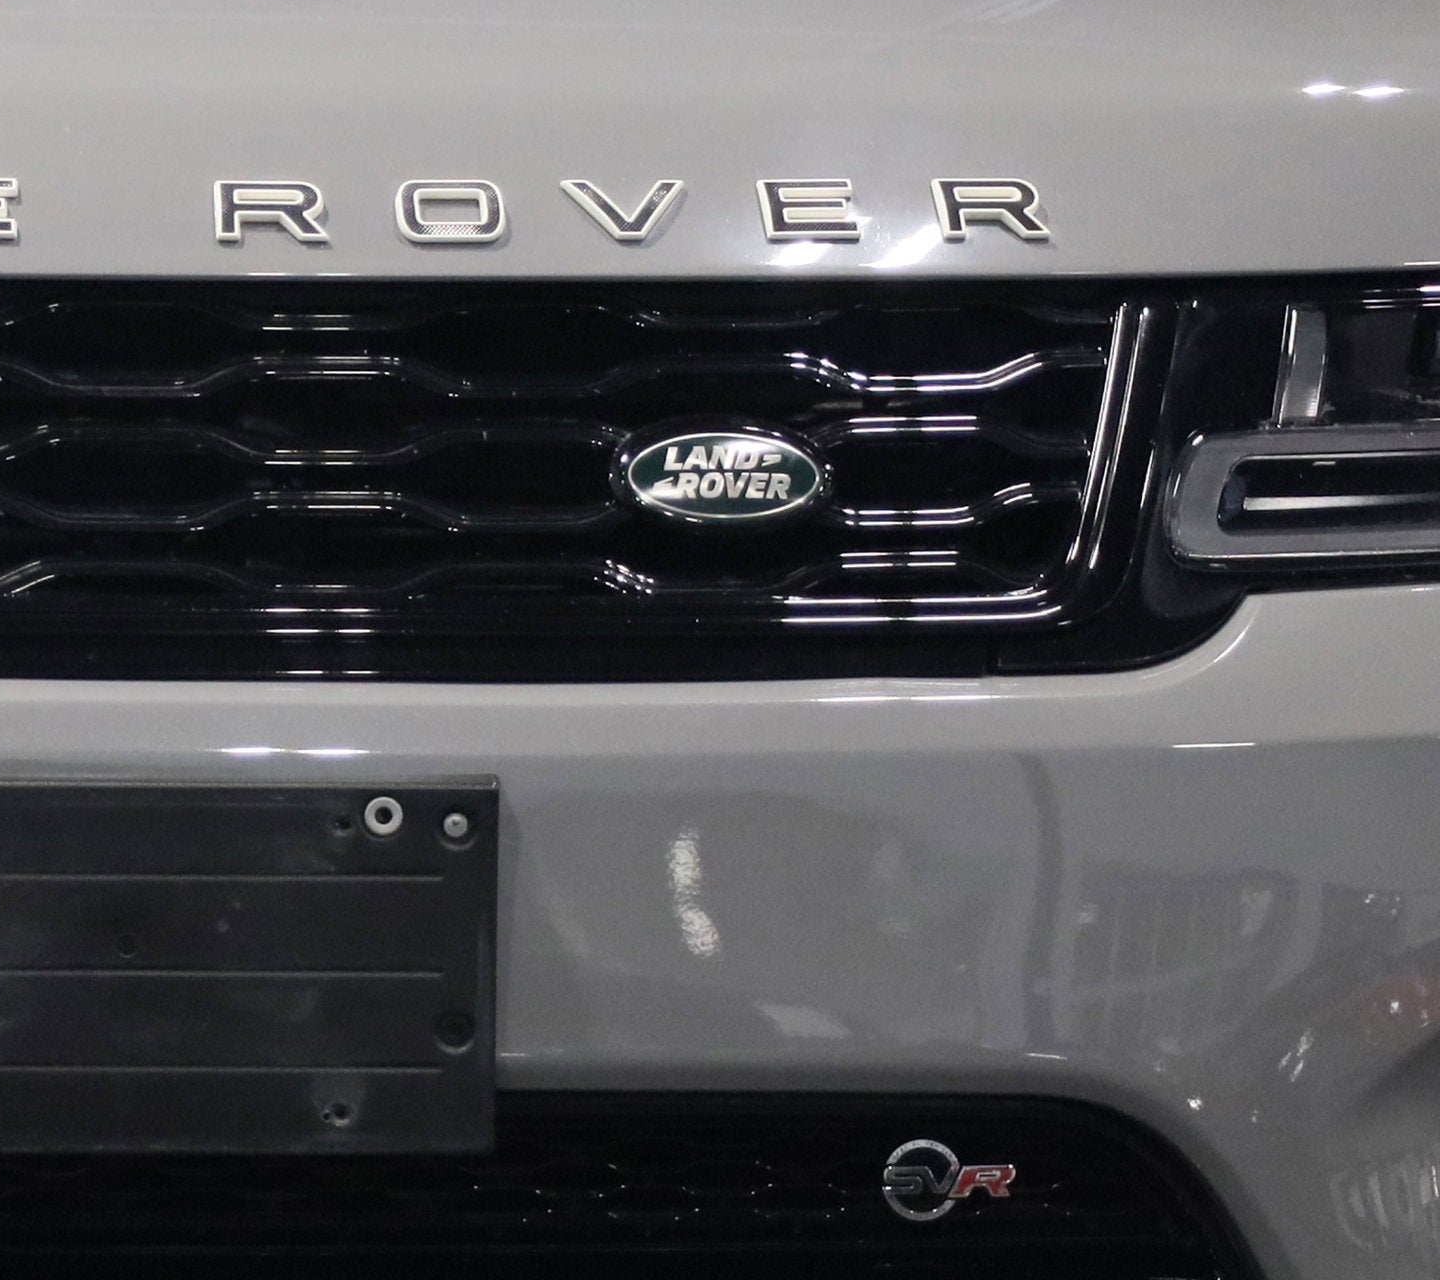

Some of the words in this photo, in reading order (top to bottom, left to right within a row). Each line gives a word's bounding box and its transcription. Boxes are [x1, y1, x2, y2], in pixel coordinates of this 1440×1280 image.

[214, 178, 1050, 242] ROVER
[663, 445, 758, 471] LAND
[676, 471, 792, 500] ROVER
[883, 1165, 1016, 1200] SVR
